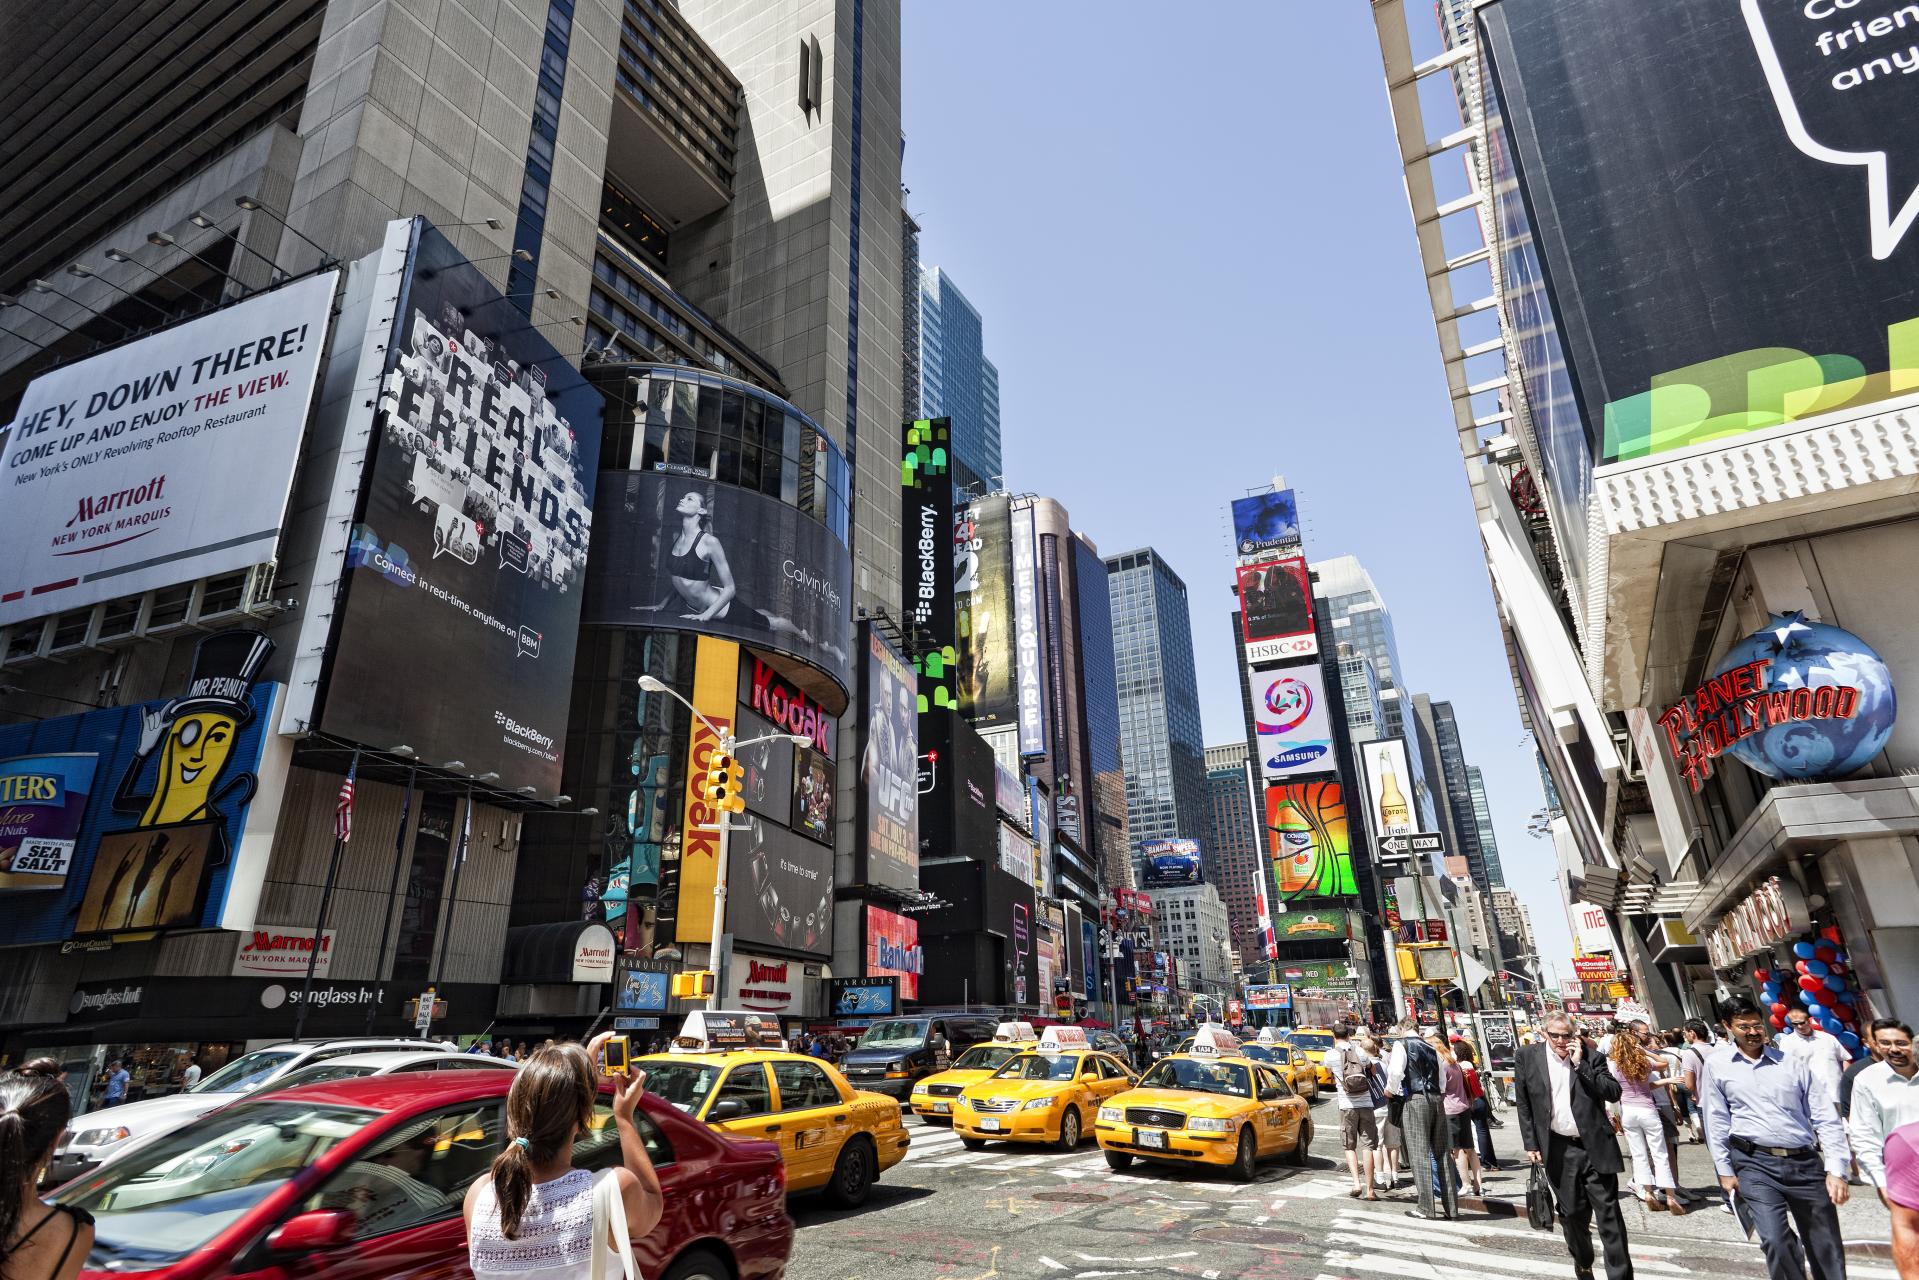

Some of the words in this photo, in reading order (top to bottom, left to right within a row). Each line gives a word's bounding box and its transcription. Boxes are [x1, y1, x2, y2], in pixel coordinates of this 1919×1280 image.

[16, 399, 78, 442] HEY,
[85, 366, 183, 420] DOWN
[192, 323, 309, 385] THERE!
[10, 439, 58, 469] COME
[61, 431, 86, 453] UP
[86, 419, 127, 446] AND
[129, 399, 191, 432] ENJOY
[194, 386, 232, 412] THE
[237, 369, 290, 399] VIEW.
[449, 354, 545, 466] REAL
[15, 471, 37, 486] New
[39, 459, 69, 479] York's
[71, 450, 101, 470] ONLY
[103, 434, 155, 462] Revolving
[157, 422, 202, 445] Rooftop
[204, 403, 267, 432] Restaurant
[397, 375, 583, 548] FRIENDS
[65, 474, 167, 528] Marriott
[954, 507, 981, 525] EFT
[51, 527, 85, 547] NEW
[86, 519, 114, 538] YORK
[115, 505, 172, 533] MARQUIS
[918, 501, 939, 599] BlackBerry
[1255, 534, 1299, 549] Prudential
[1012, 520, 1033, 604] TIMES
[374, 552, 417, 585] Connect
[418, 576, 428, 591] in
[429, 585, 473, 615] real-time,
[472, 607, 506, 633] anytime
[506, 626, 517, 638] on
[782, 559, 821, 594] Calvin
[822, 580, 842, 611] Klein
[520, 632, 538, 650] BBM
[1250, 642, 1290, 659] HSBC
[1019, 614, 1039, 726] SQUARE
[189, 678, 212, 698] MR.
[212, 676, 249, 700] PEANUT
[751, 656, 831, 756] Kodak
[1656, 657, 1774, 761] PLANET
[505, 717, 553, 750] BlackBerry
[1679, 684, 1861, 795] HOLLYWOOD
[1274, 750, 1321, 763] SAMSUNG
[0, 775, 57, 802] TERS
[686, 715, 731, 859] Kodak
[879, 763, 912, 821] UFC
[5, 826, 29, 837] Nuts
[1387, 840, 1407, 850] ONE
[1414, 838, 1434, 848] WAY
[16, 856, 66, 872] SALT
[27, 845, 63, 859] SEA
[243, 931, 332, 953] Marriot
[580, 947, 610, 958] Marriott
[878, 936, 905, 972] Bank
[239, 953, 260, 962] NEW
[262, 954, 286, 963] YORK
[620, 958, 669, 971] MARQUIS
[745, 960, 788, 985] Marriott
[834, 978, 894, 987] MARQUIS
[1305, 970, 1319, 978] NED
[82, 987, 122, 1012] sunglass
[122, 986, 143, 1004] hut
